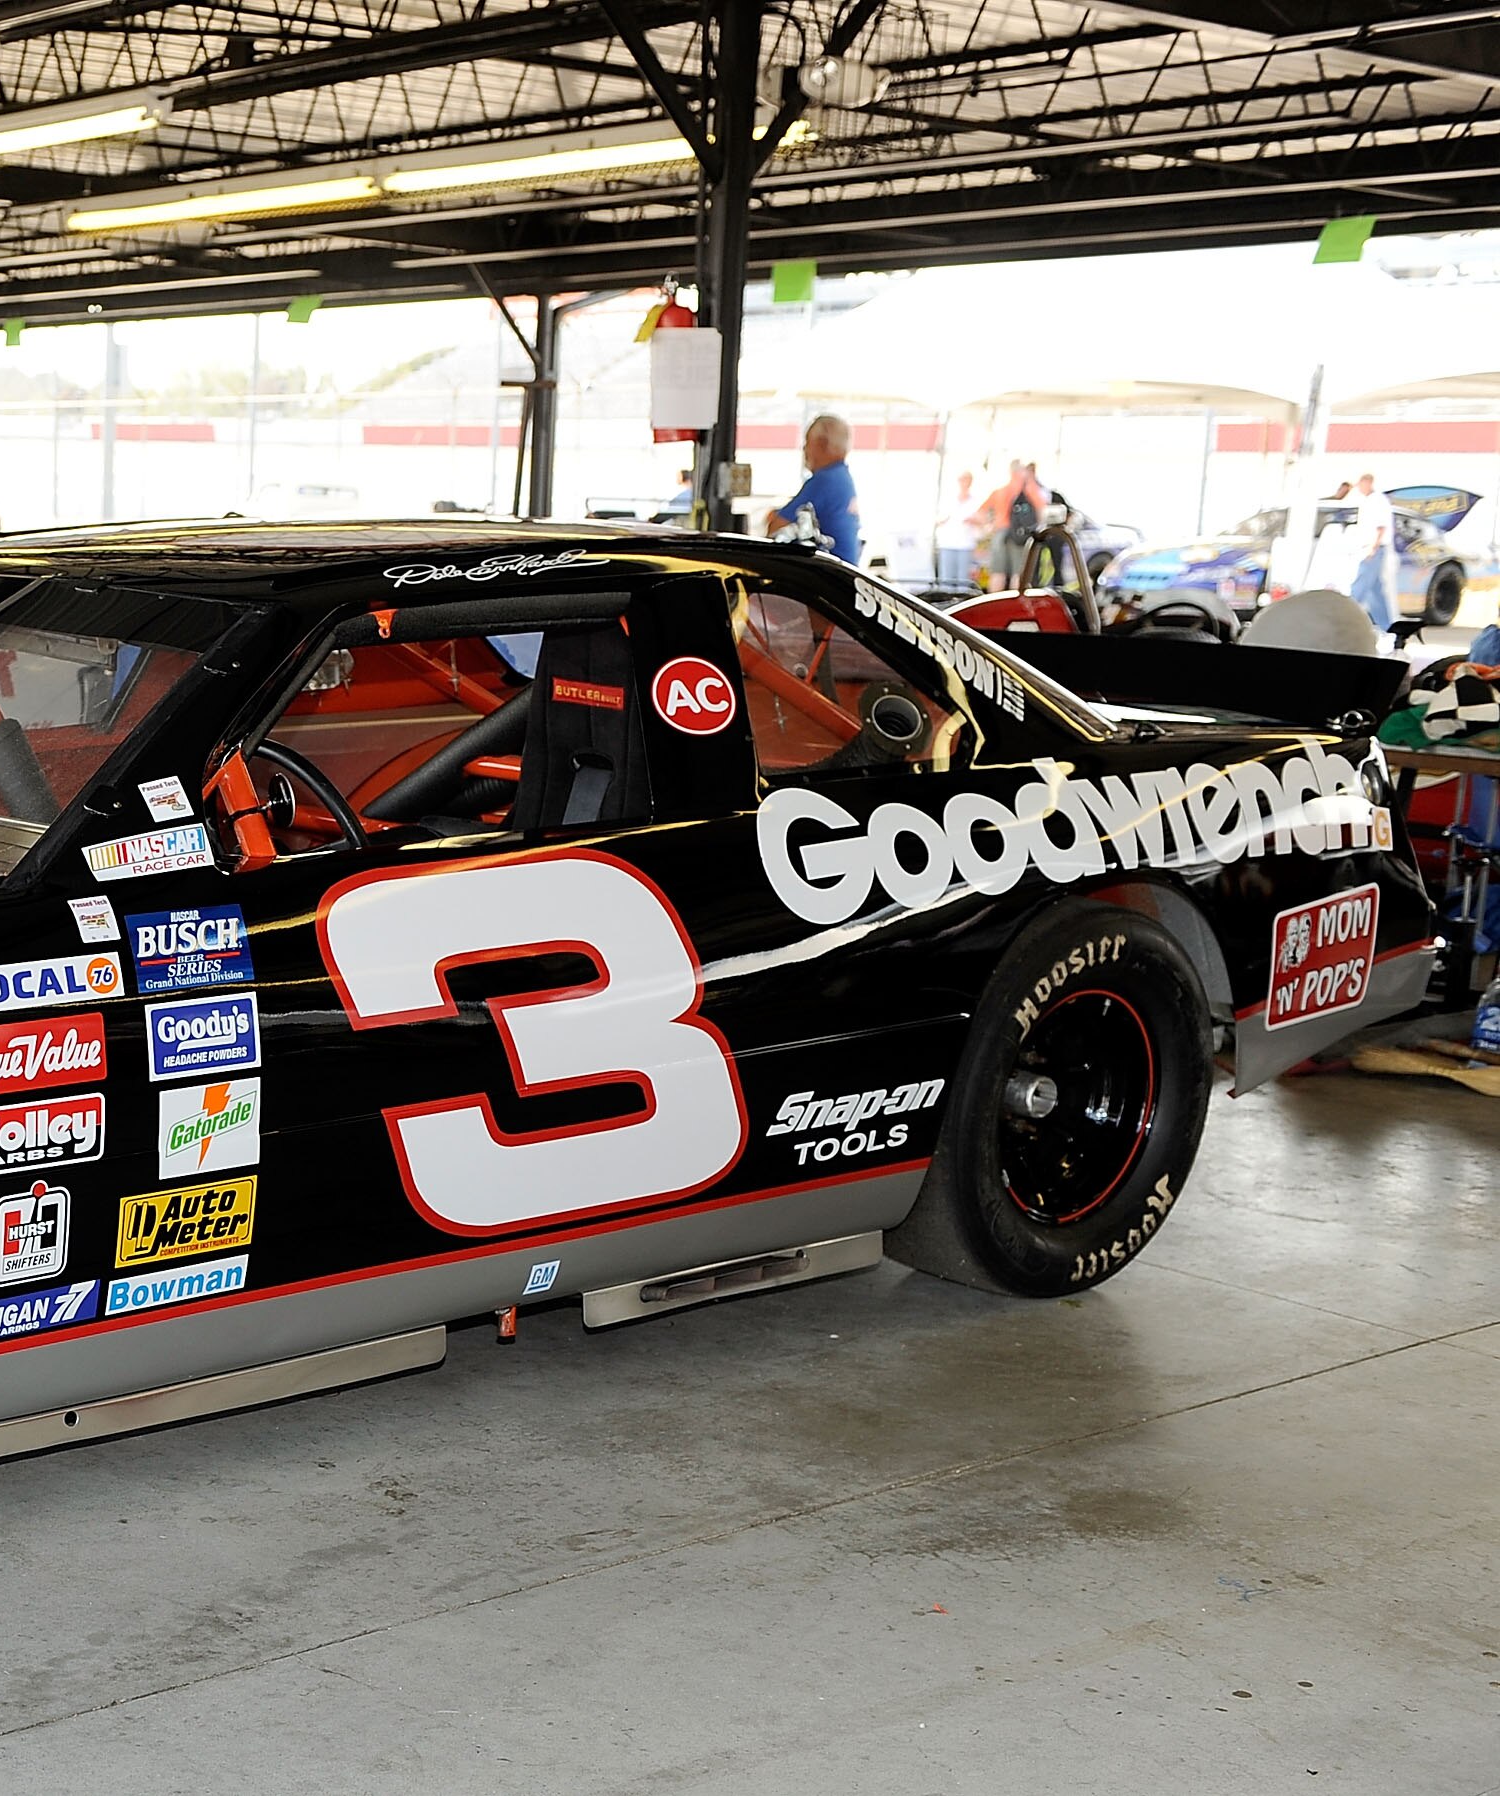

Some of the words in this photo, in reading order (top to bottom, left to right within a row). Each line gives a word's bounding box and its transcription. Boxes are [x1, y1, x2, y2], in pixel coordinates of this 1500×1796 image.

[384, 564, 462, 588] Dale
[854, 576, 996, 699] STETSON
[665, 675, 729, 718] AC
[126, 828, 201, 863] NASCAR
[756, 737, 1369, 924] Goodwrench
[132, 859, 173, 875] RACE
[176, 854, 206, 867] CAR
[137, 917, 240, 959] BUSCH
[1317, 896, 1372, 948] MOM
[90, 966, 114, 986] 76
[167, 959, 222, 978] SERIES
[177, 953, 205, 964] BEER
[145, 976, 173, 989] Grand
[174, 973, 210, 987] National
[211, 970, 244, 984] Division
[1277, 977, 1300, 1015] 'N'
[1301, 957, 1366, 1011] POP'S
[157, 1005, 250, 1052] Goody's
[315, 847, 750, 1238] 3
[163, 1052, 207, 1068] HEADACHE
[208, 1046, 248, 1063] POWDERS
[169, 1101, 252, 1151] Gatorade
[765, 1078, 946, 1137] Snap-on
[794, 1123, 909, 1166] TOOLS
[161, 1189, 238, 1223] Auto
[9, 1220, 55, 1241] HURST
[153, 1213, 249, 1253] Meter
[160, 1244, 199, 1257] COMPETITION
[200, 1236, 240, 1250] INSTRUMENTS
[5, 1252, 51, 1272] SHIFTERS
[531, 1265, 556, 1285] GM
[50, 1280, 97, 1324] 77
[108, 1265, 243, 1311] Bowman
